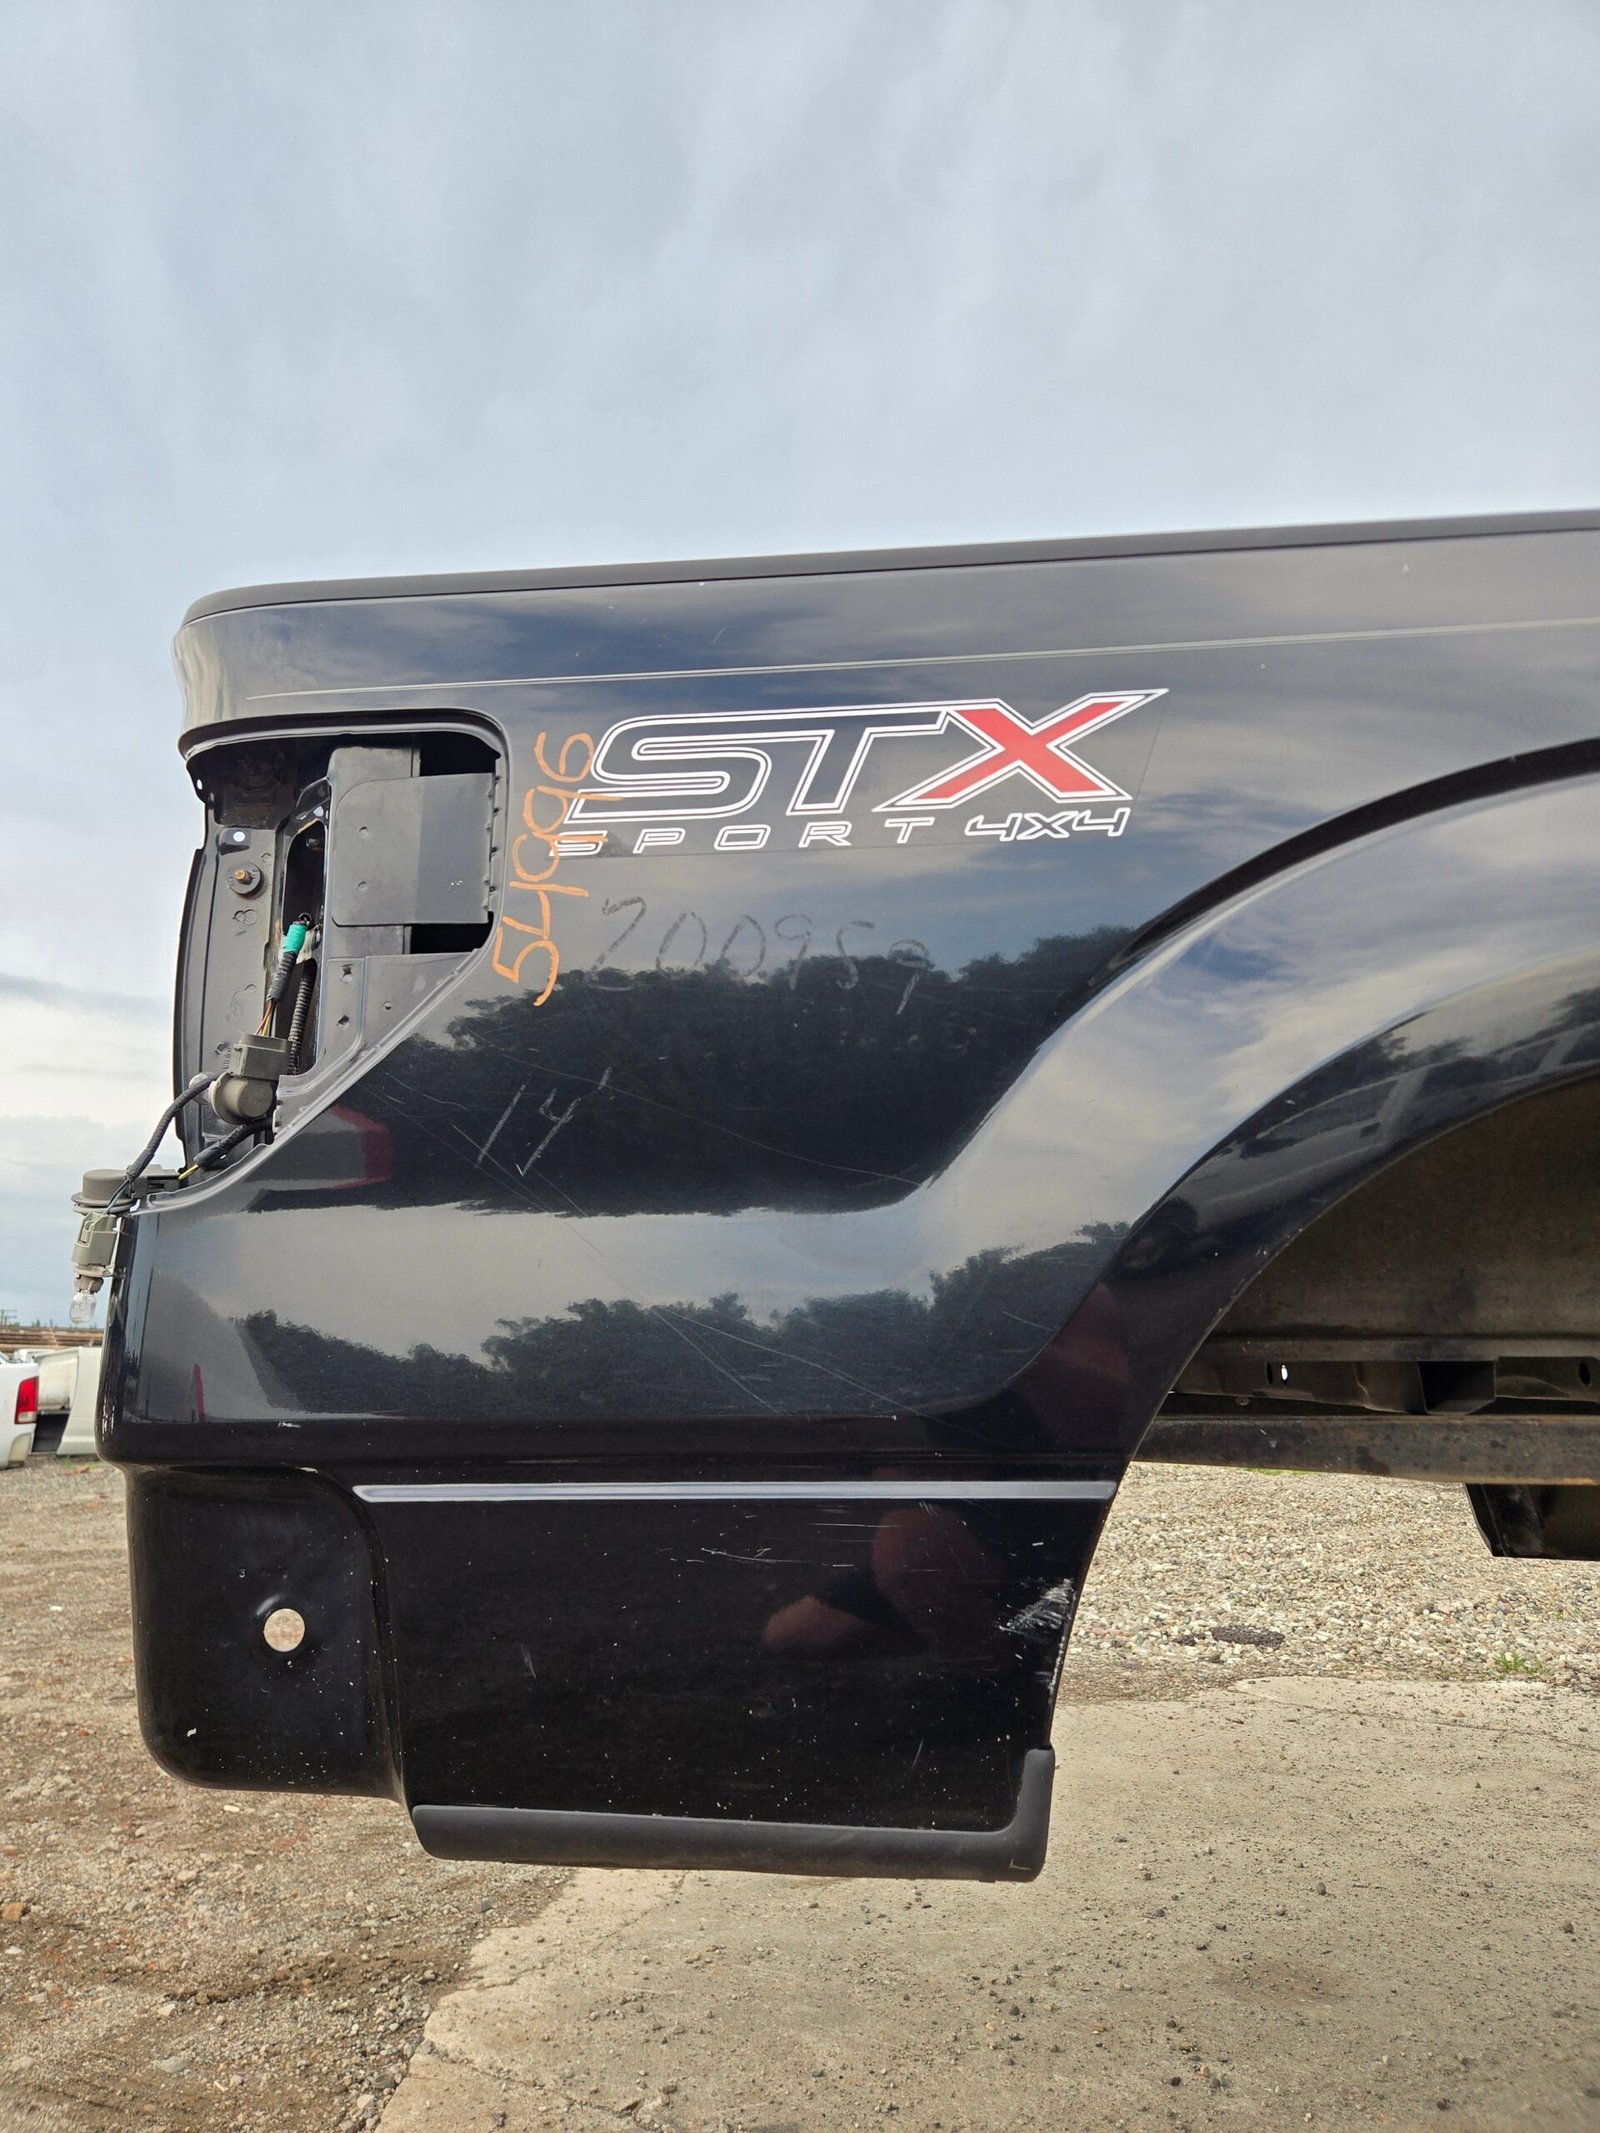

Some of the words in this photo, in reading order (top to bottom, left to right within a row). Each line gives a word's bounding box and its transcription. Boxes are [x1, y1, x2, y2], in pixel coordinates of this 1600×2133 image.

[563, 687, 1169, 824] STX
[491, 731, 624, 1007] 54996
[548, 816, 936, 857] SPORT
